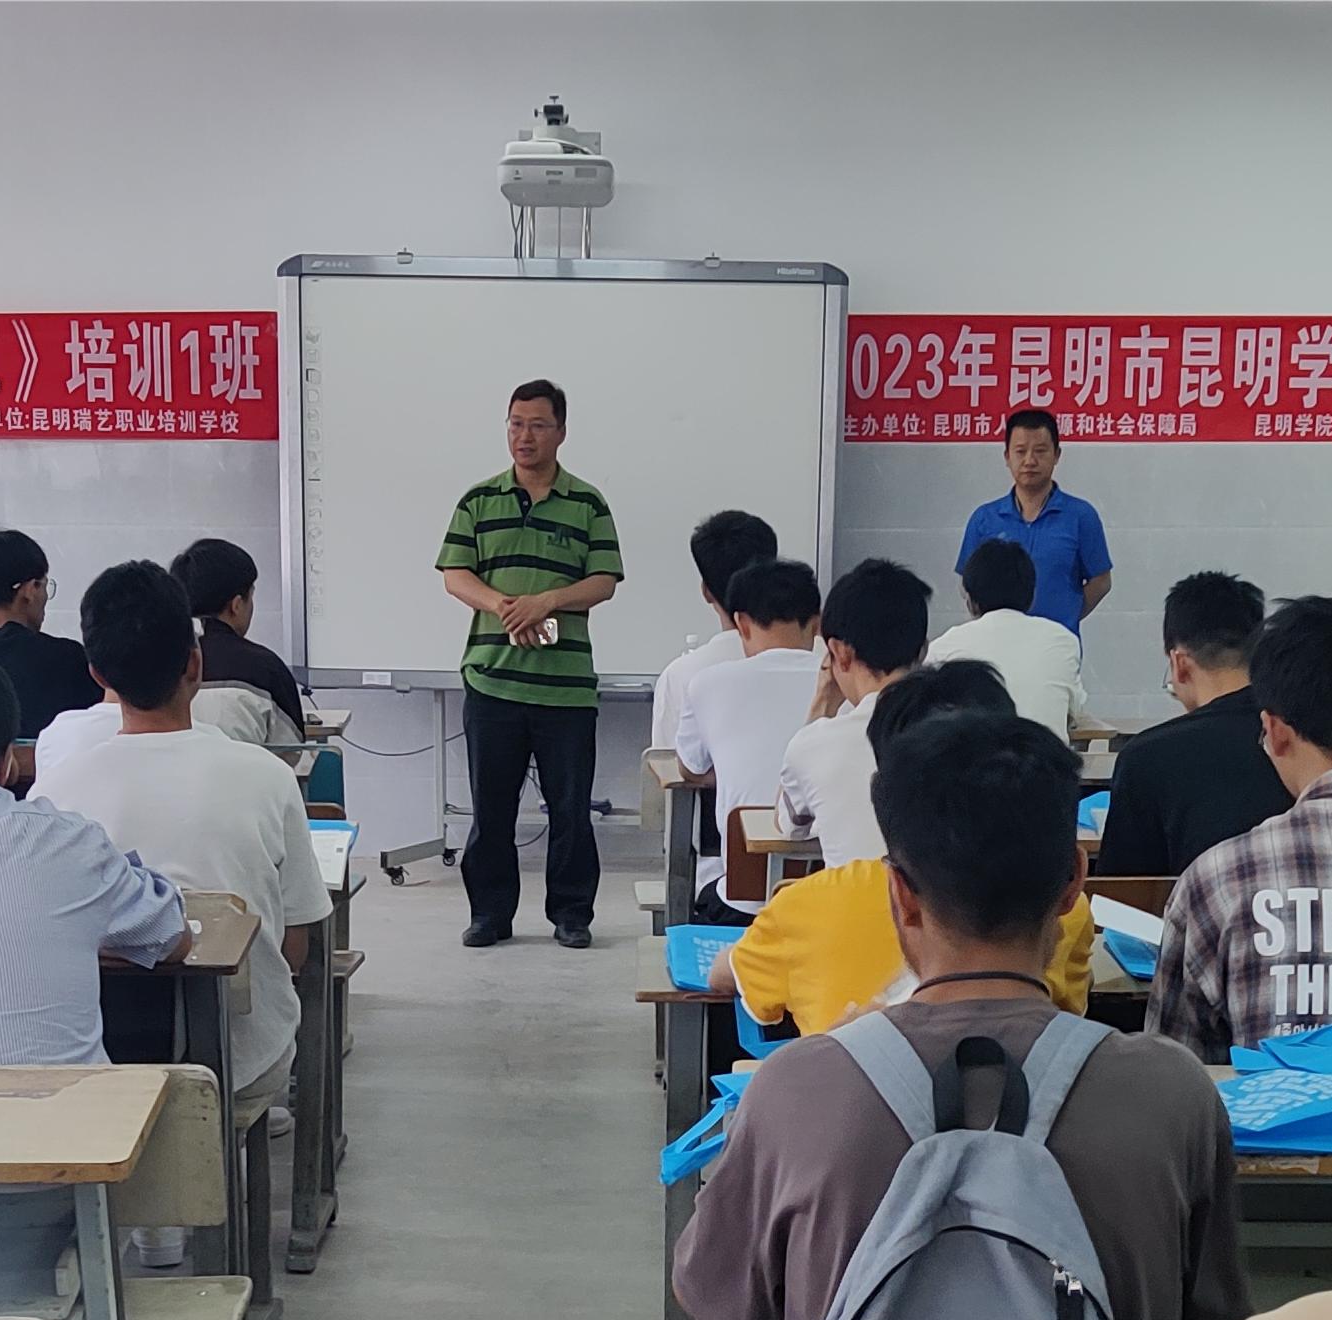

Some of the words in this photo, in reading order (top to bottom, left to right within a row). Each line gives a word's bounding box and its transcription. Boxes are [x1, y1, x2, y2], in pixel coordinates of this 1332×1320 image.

[844, 412, 1197, 437] 主办单位:昆明市人源和社会保障局
